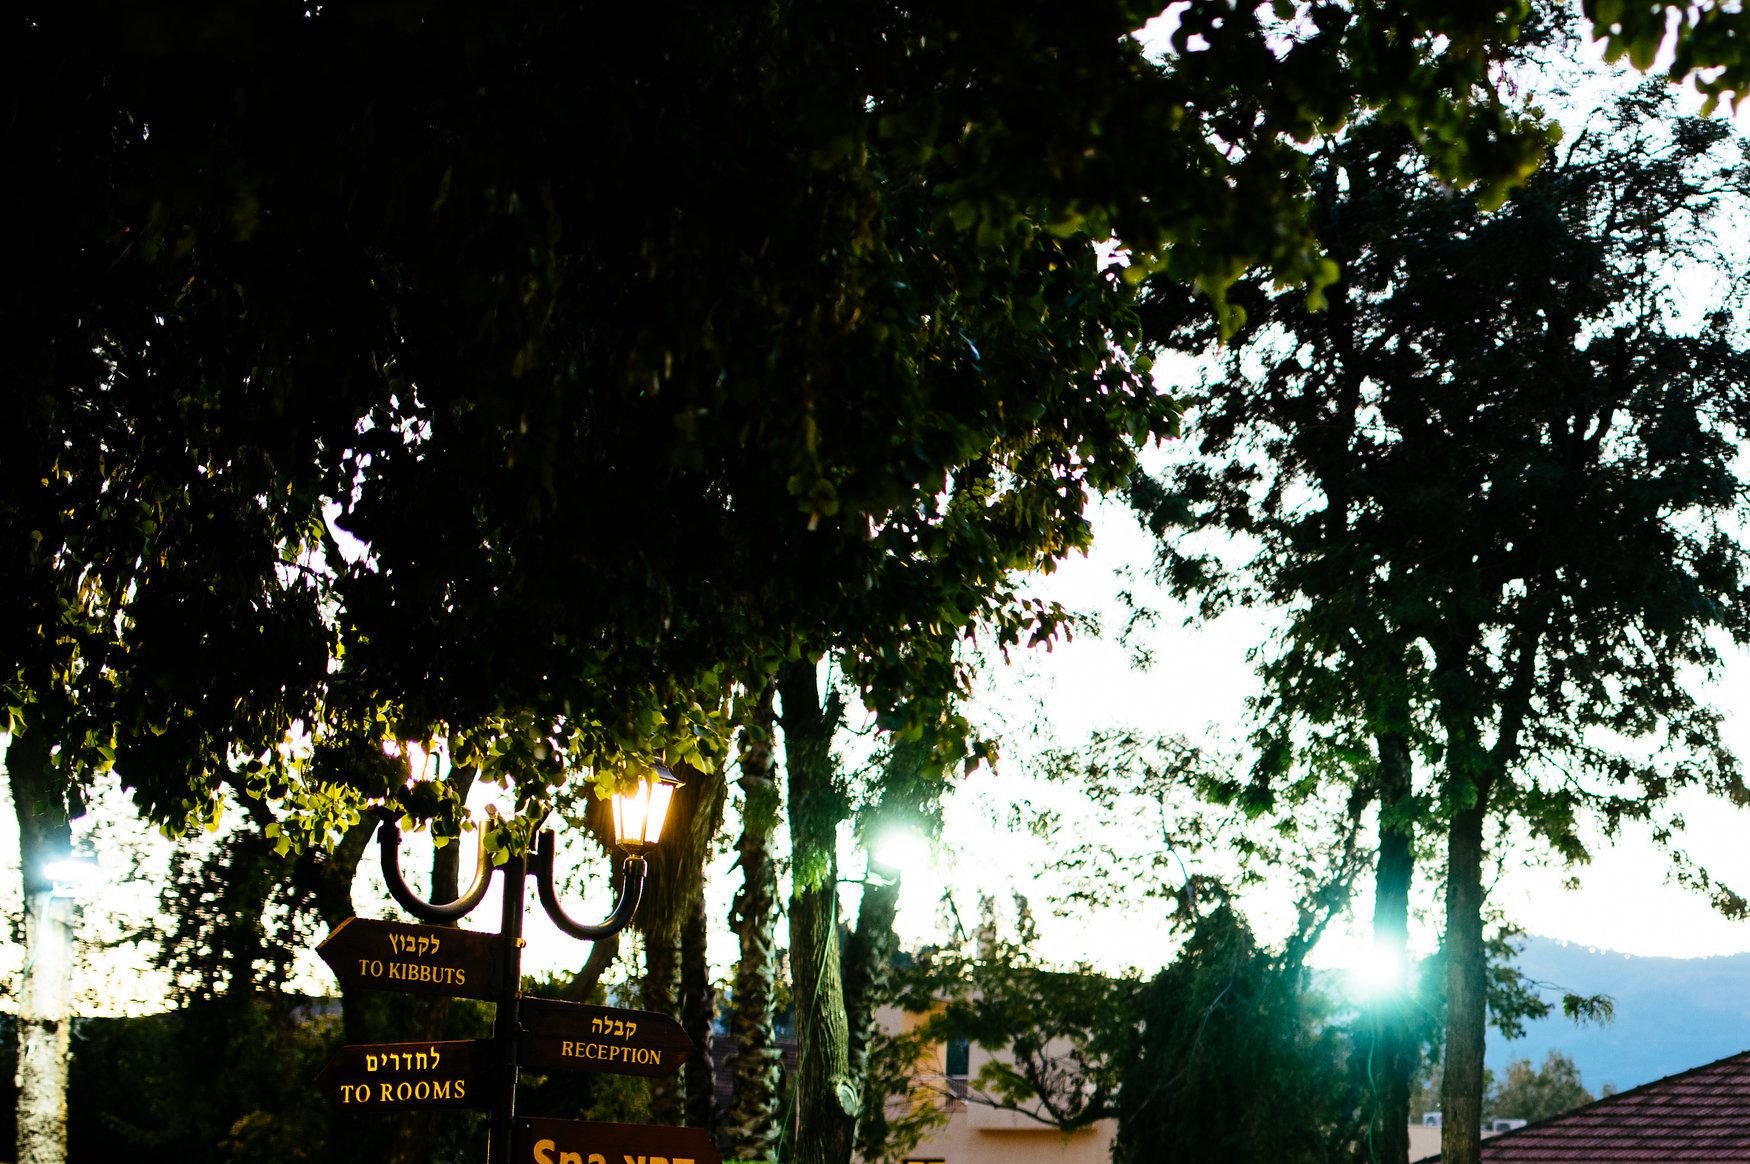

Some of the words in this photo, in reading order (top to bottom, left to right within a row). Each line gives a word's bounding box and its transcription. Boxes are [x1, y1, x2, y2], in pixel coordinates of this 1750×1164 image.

[388, 932, 440, 957] לקבוץ
[358, 959, 384, 978] TO
[388, 962, 466, 986] KIBBUTS
[591, 1015, 637, 1041] קבלה
[365, 1045, 441, 1072] לחדרים
[561, 1040, 662, 1065] RECEPTION
[340, 1083, 371, 1105] TO
[379, 1079, 466, 1103] ROOMS
